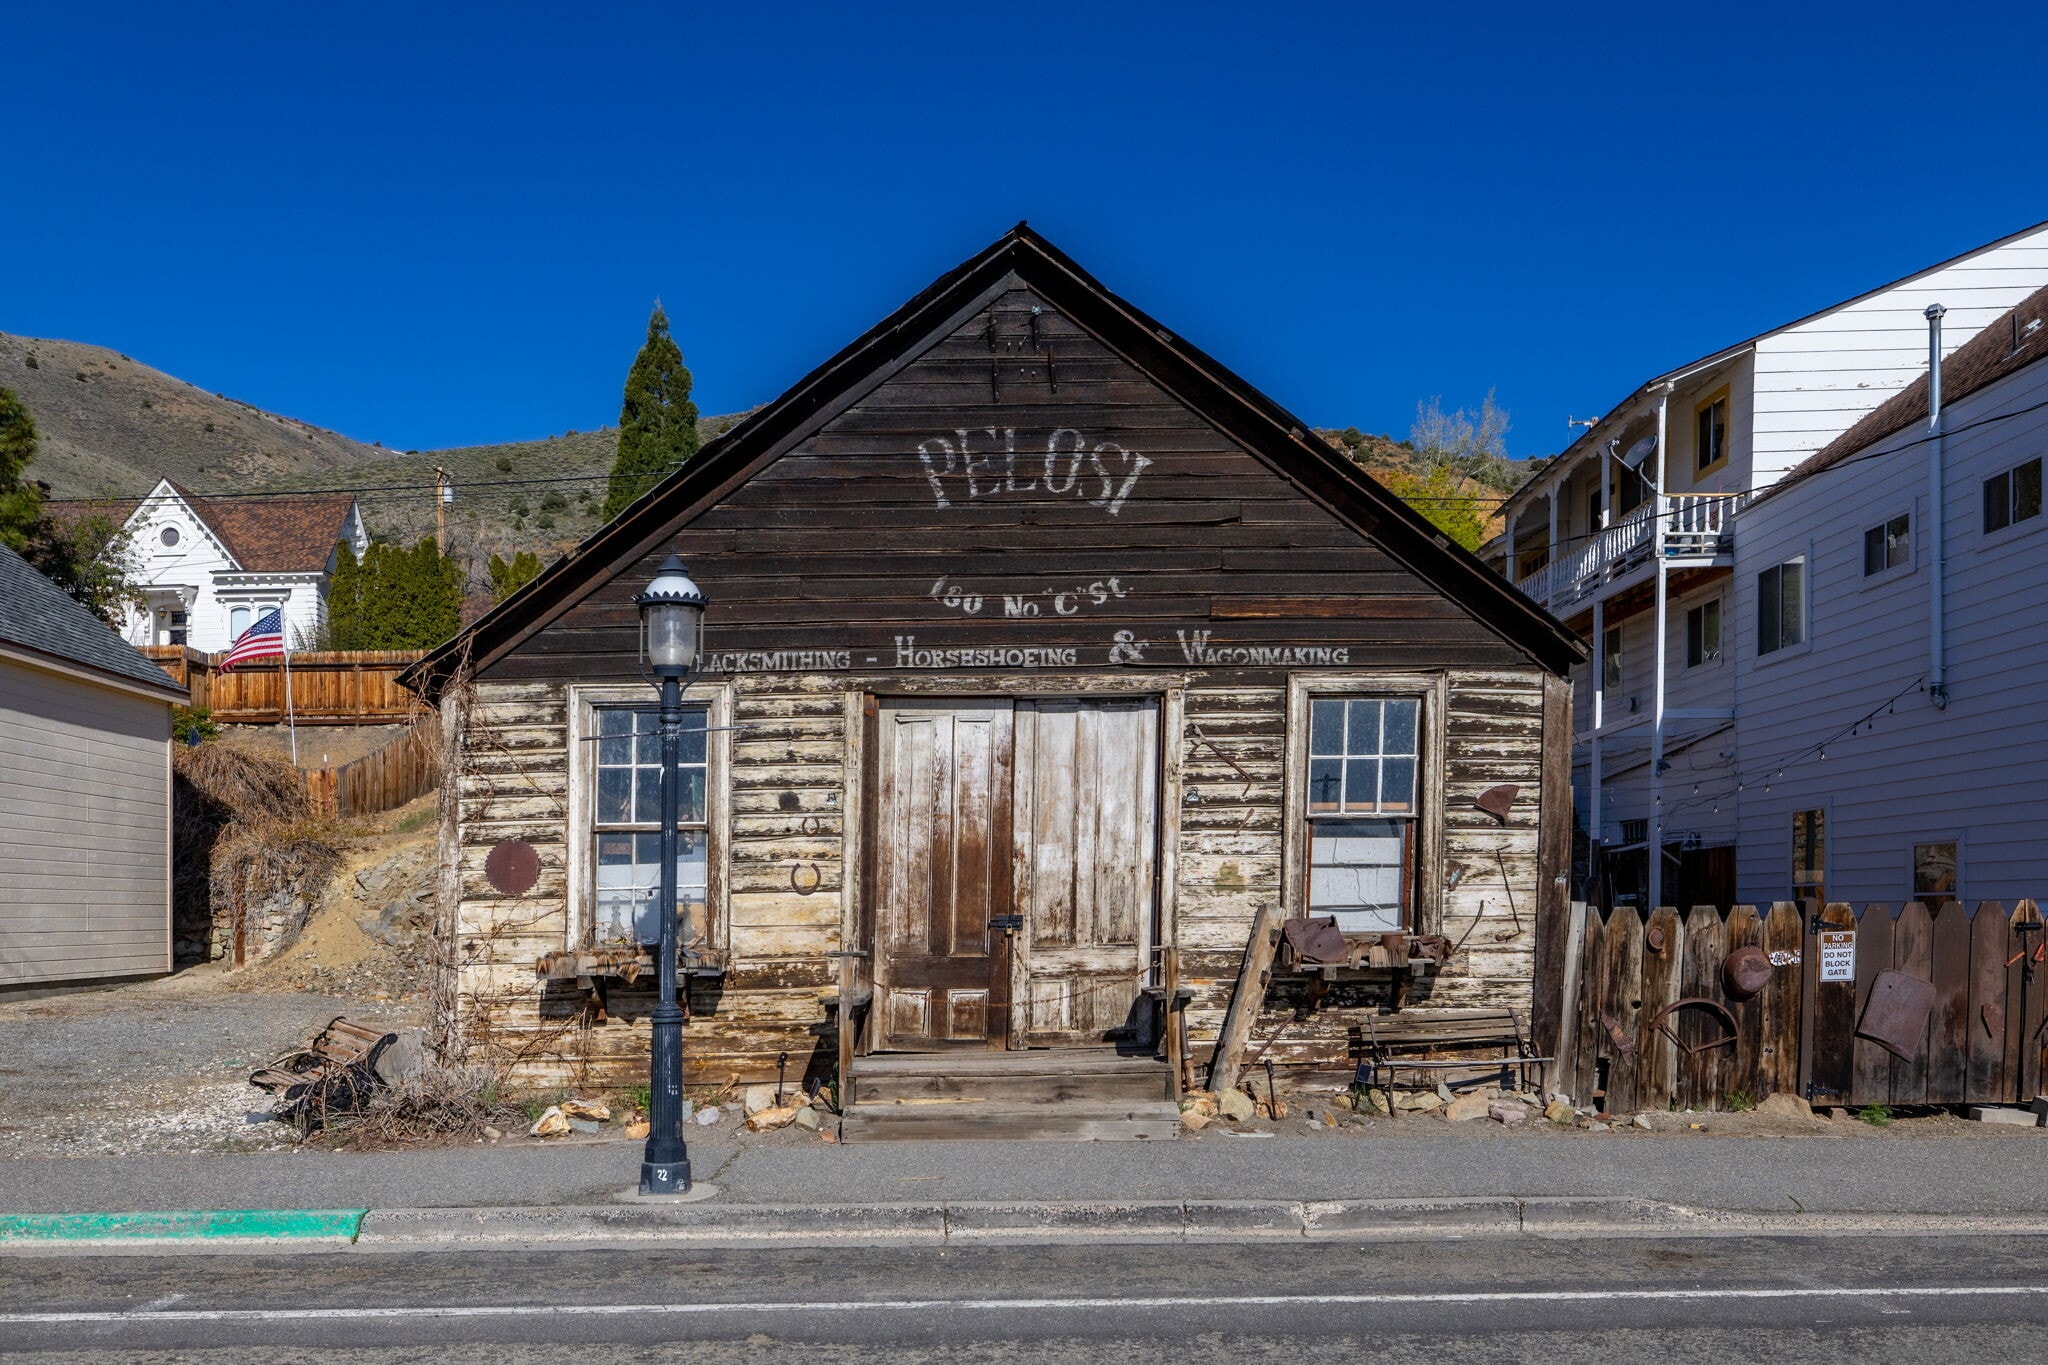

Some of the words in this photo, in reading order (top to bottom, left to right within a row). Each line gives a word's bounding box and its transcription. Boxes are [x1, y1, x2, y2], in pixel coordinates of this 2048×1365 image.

[695, 651, 850, 673] LACKSMITHING
[895, 635, 1077, 668] HORSESHOEING
[1108, 629, 1150, 663] &
[1176, 629, 1350, 664] WAGONMAKING
[1832, 934, 1845, 942] NO
[657, 1169, 668, 1182] 22
